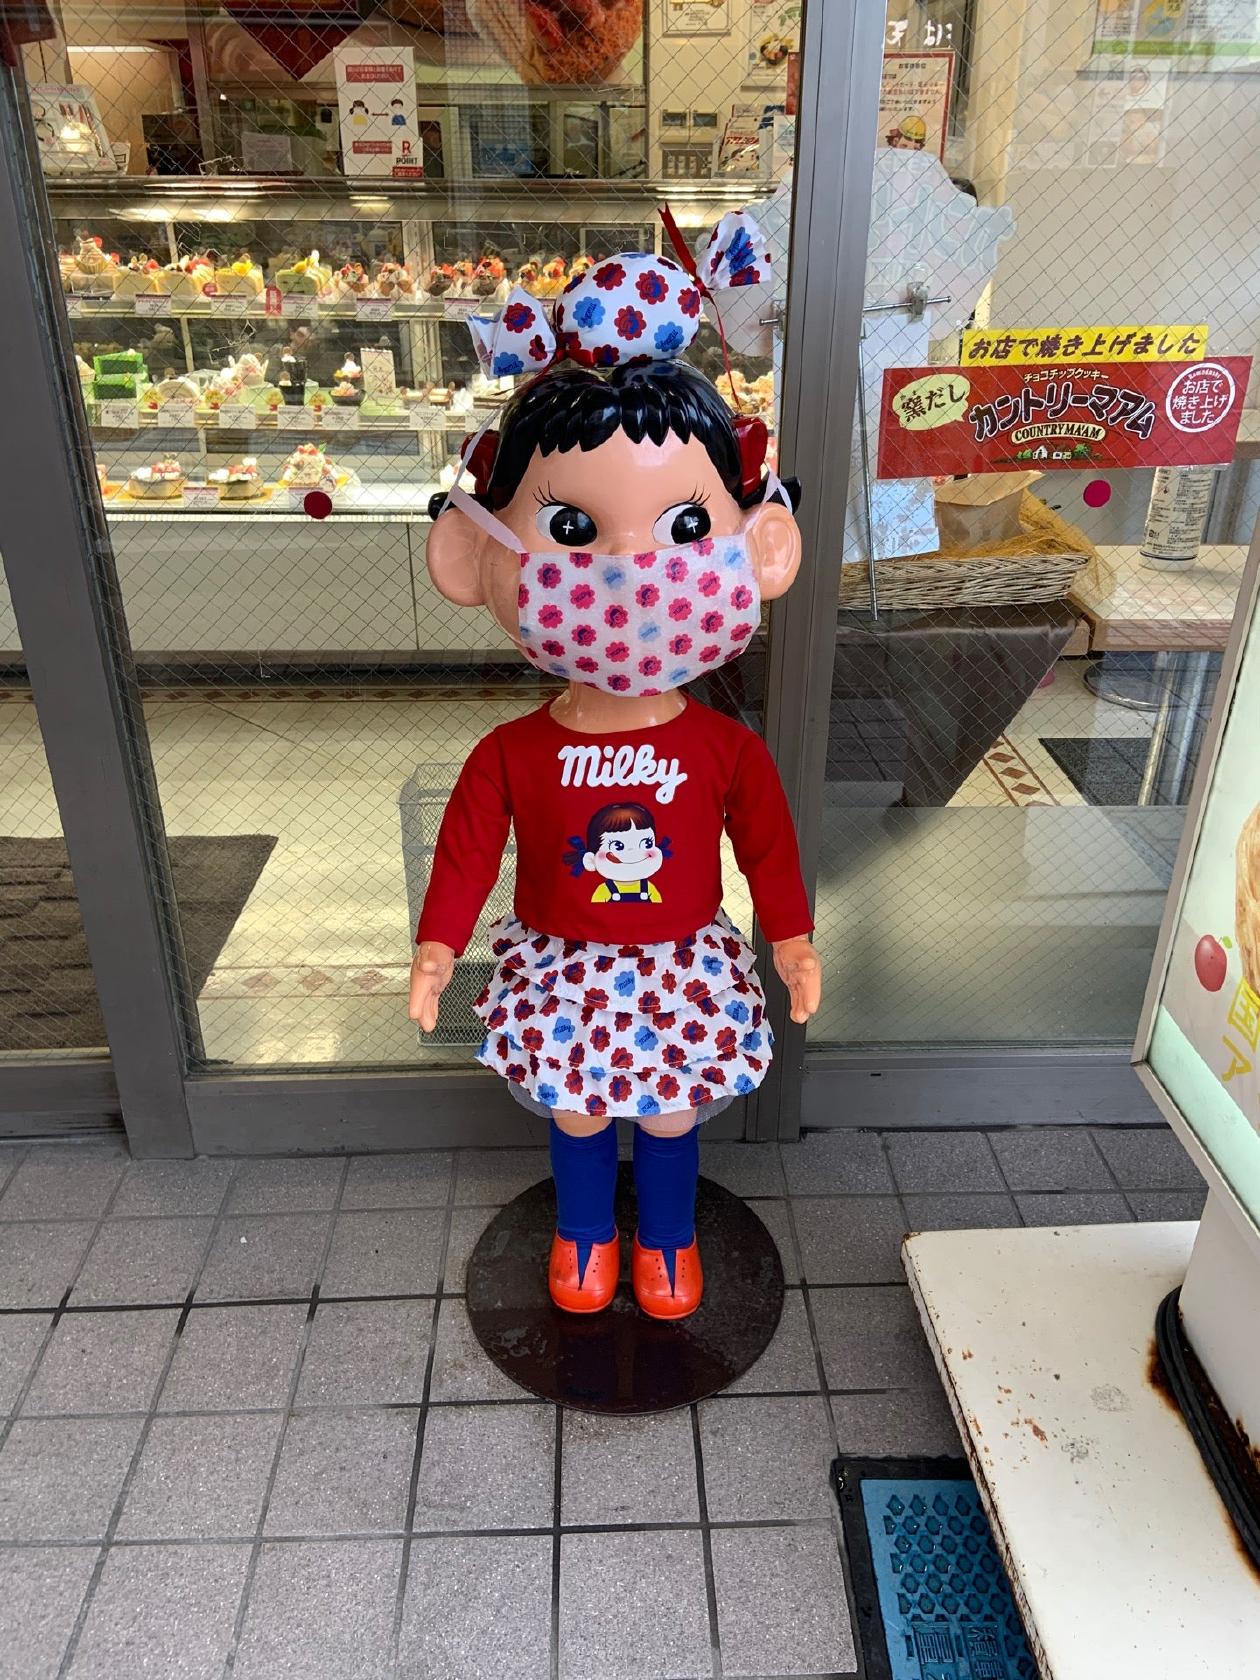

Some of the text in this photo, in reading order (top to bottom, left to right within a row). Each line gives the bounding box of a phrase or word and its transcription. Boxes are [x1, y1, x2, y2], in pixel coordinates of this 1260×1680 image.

[967, 332, 1201, 360] お店で焼き上げました
[1024, 368, 1109, 383] チョコチップクッキー
[1182, 379, 1224, 395] お店で
[1172, 394, 1229, 410] 焼き上げ
[969, 382, 1156, 442] カントリーマアム
[1180, 410, 1215, 425] ました
[1014, 424, 1101, 441] COUNTRY MA'AM
[558, 744, 688, 804] Milky
